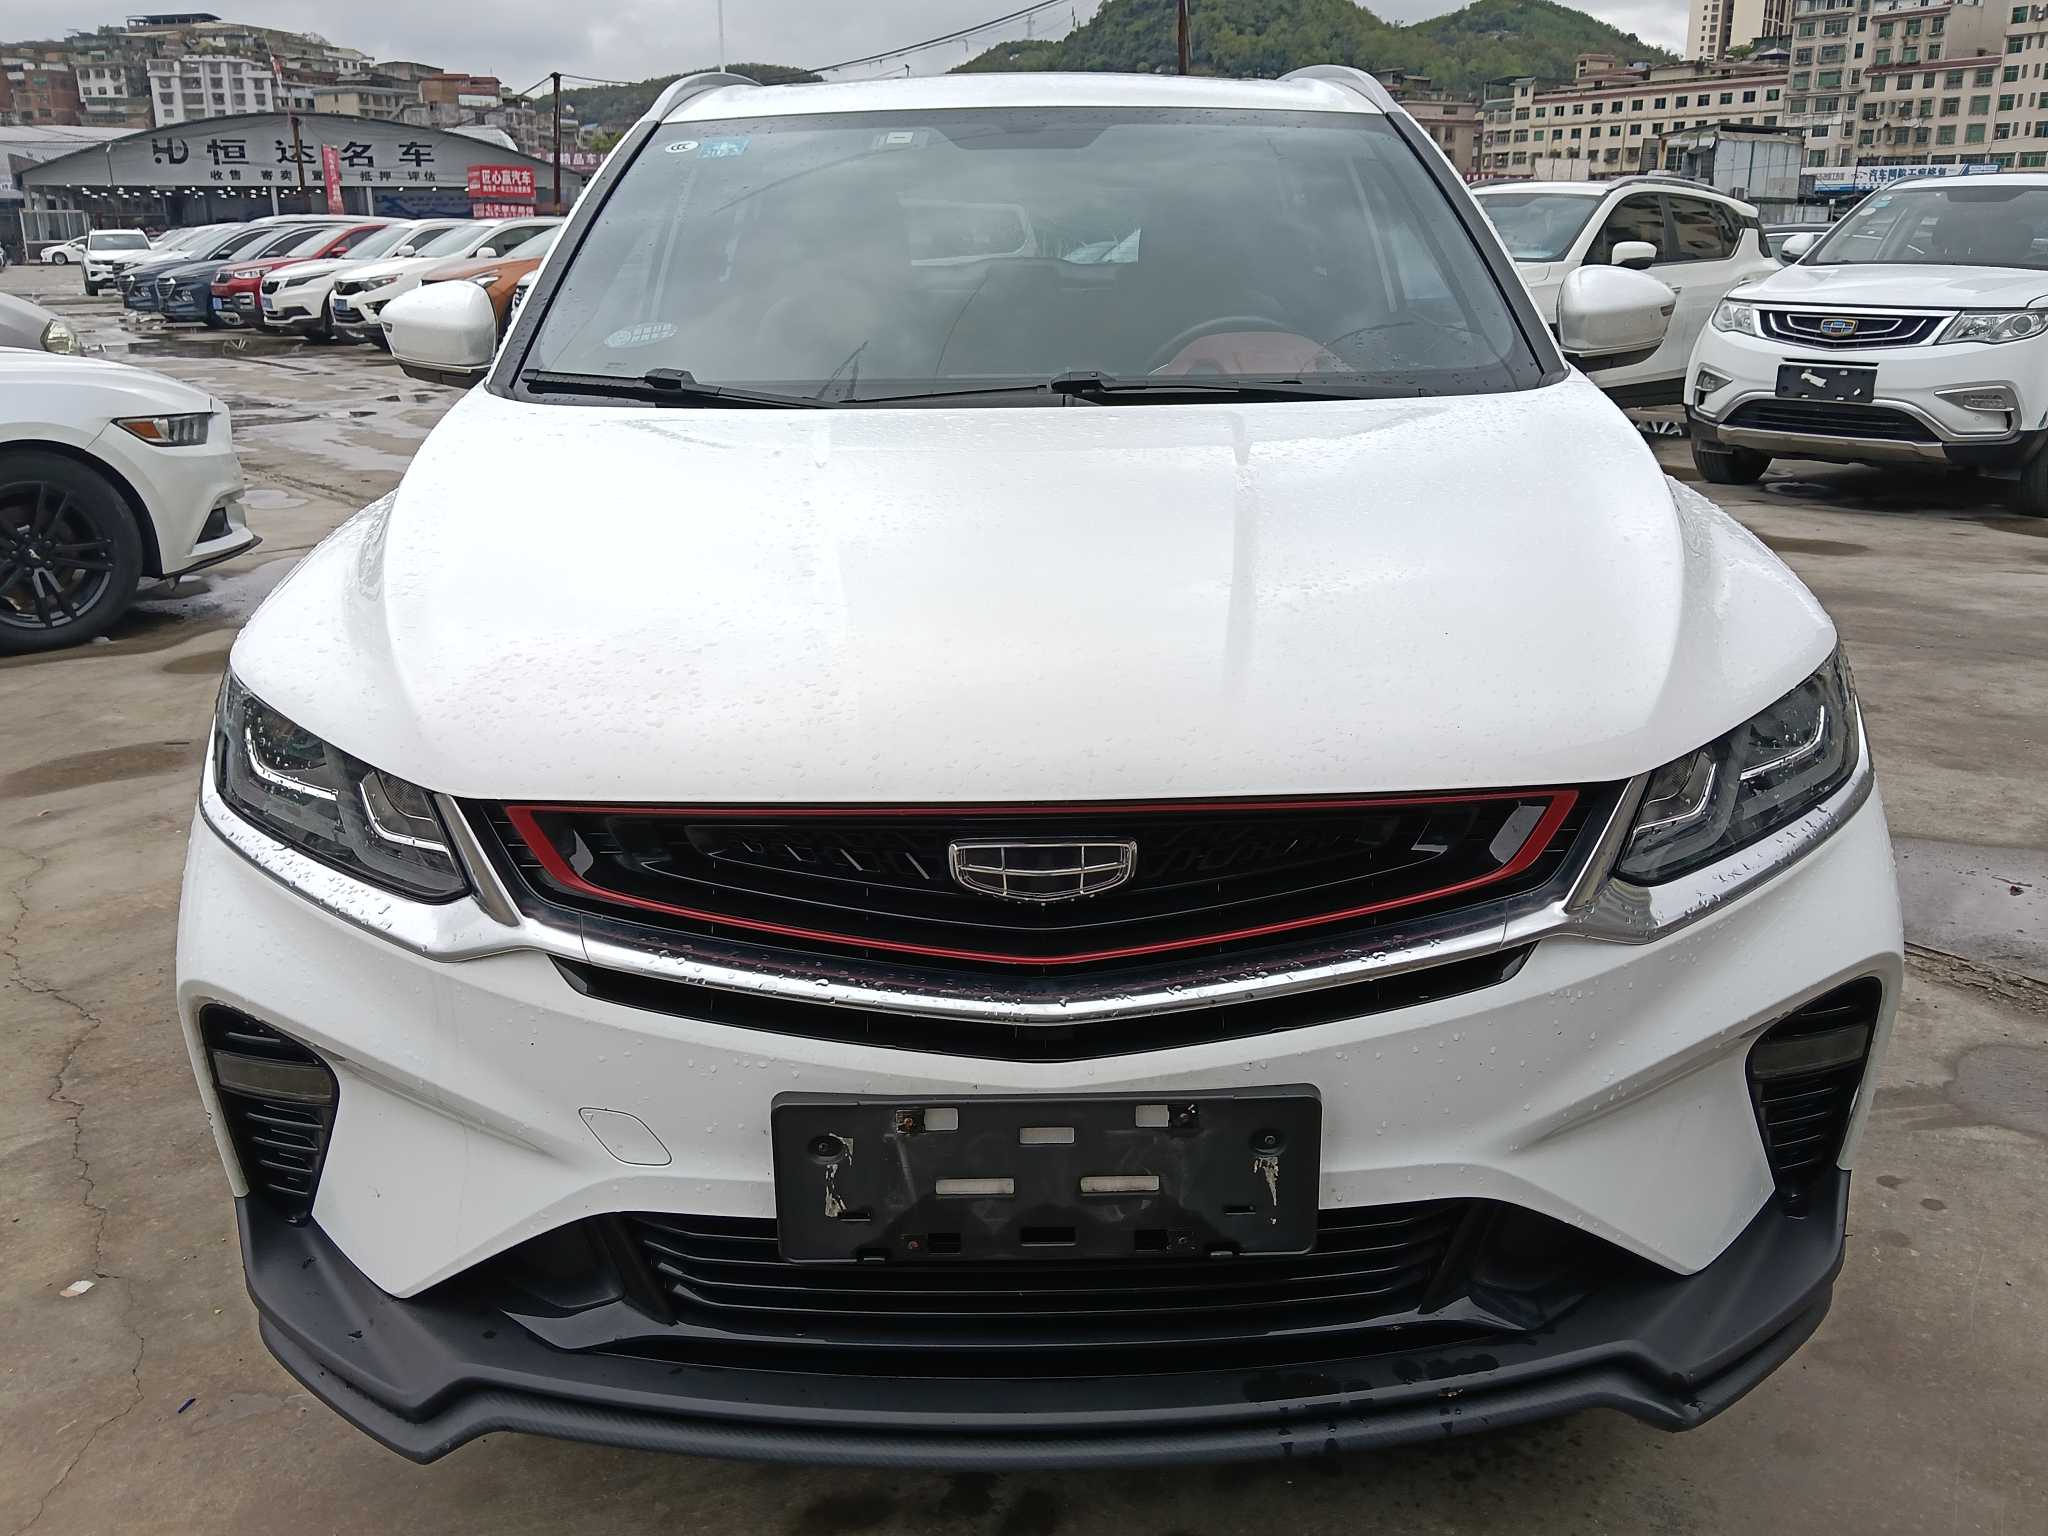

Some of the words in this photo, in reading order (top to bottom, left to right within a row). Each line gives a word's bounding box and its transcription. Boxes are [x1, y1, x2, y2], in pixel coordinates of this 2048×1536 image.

[206, 139, 435, 168] 恒达名车
[360, 170, 392, 182] 抵押
[407, 170, 437, 182] 评估
